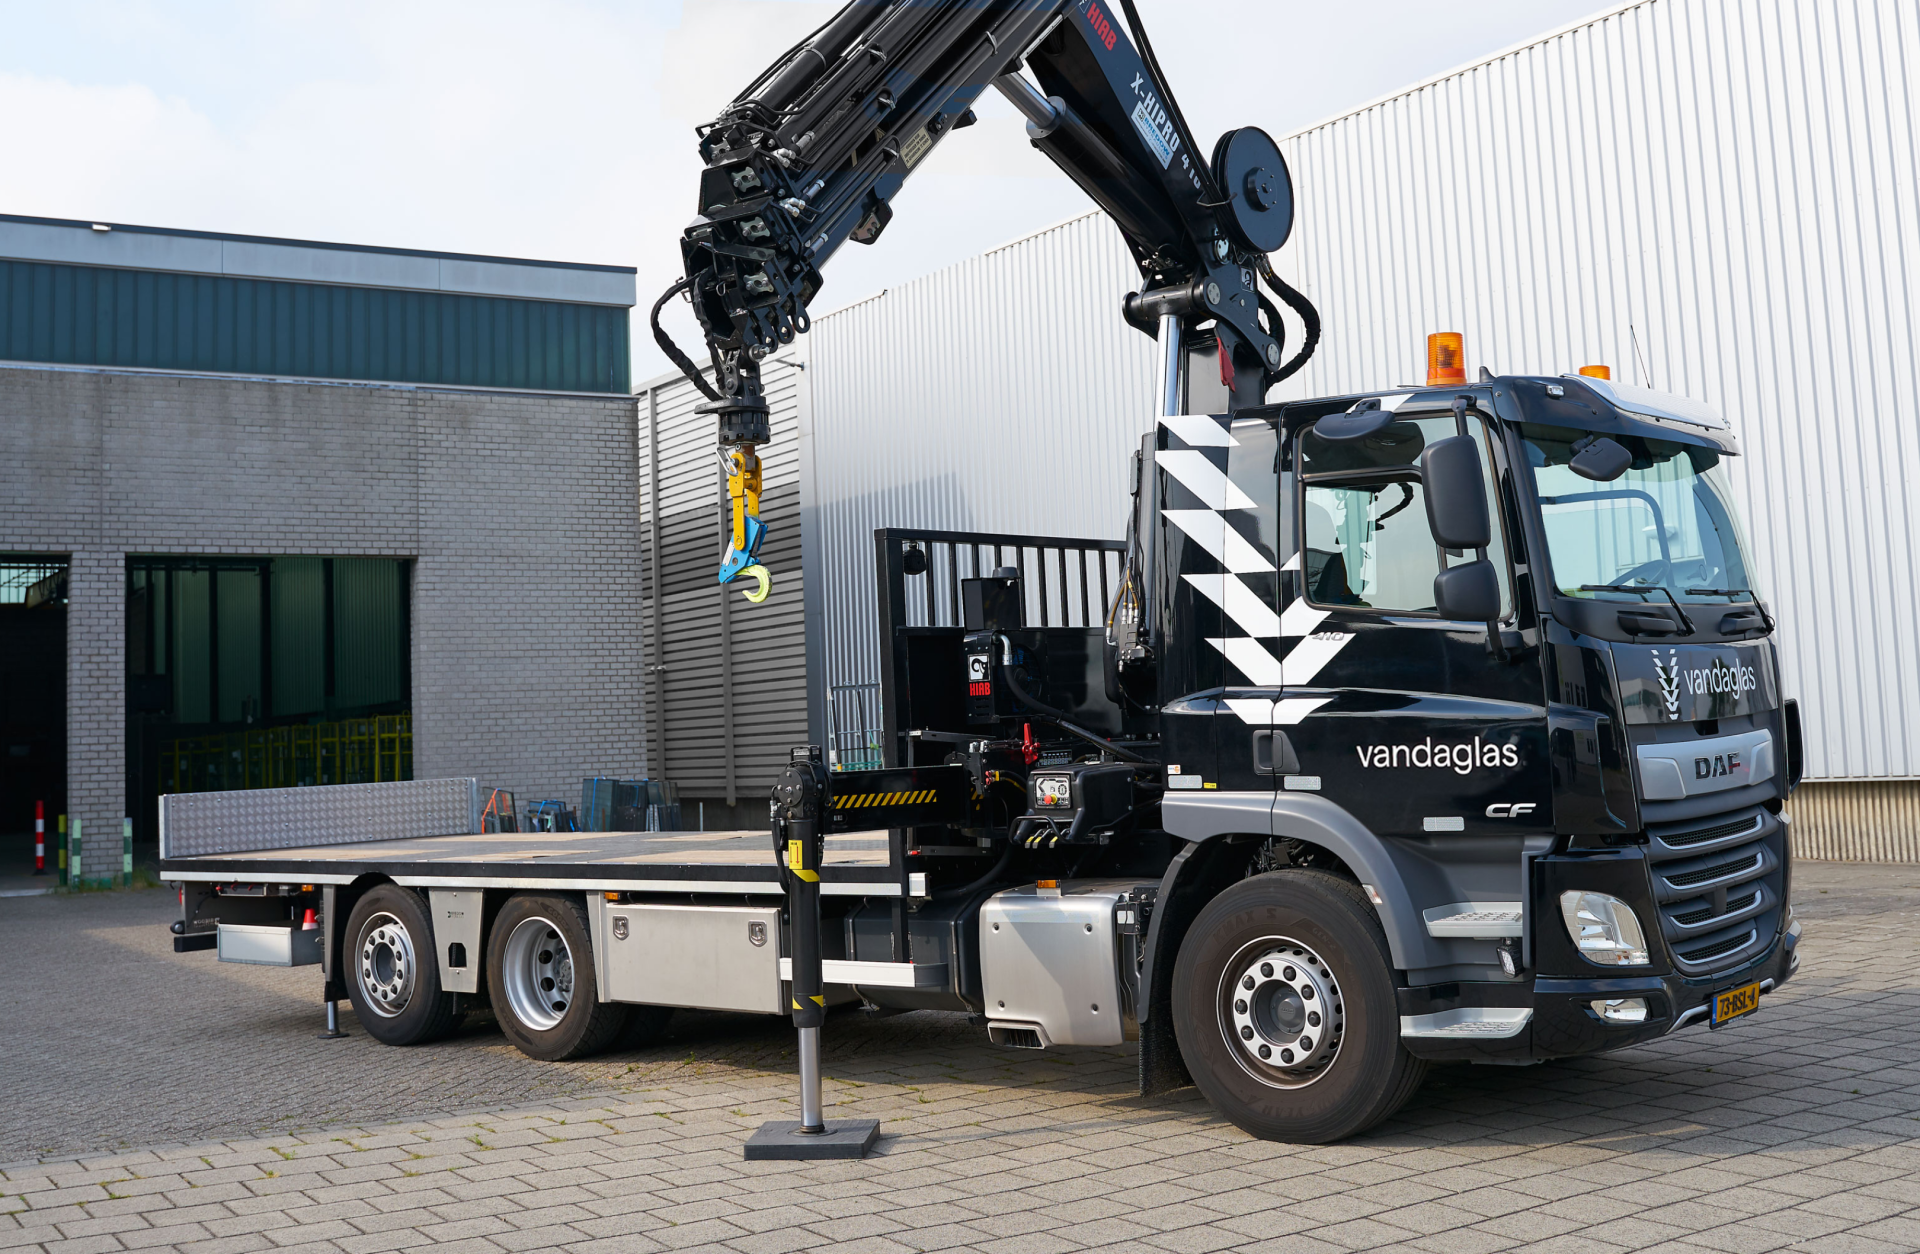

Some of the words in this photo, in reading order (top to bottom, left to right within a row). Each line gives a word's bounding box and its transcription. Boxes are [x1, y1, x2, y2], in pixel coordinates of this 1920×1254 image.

[1086, 2, 1117, 51] HIAB
[1312, 631, 1345, 641] 410
[969, 682, 991, 696] HIAB
[1684, 658, 1756, 700] vandaglas
[1356, 735, 1519, 775] vandaglas
[1695, 751, 1741, 780] DAF
[1485, 803, 1537, 818] CF
[1719, 987, 1756, 1018] 73-BSL-4
